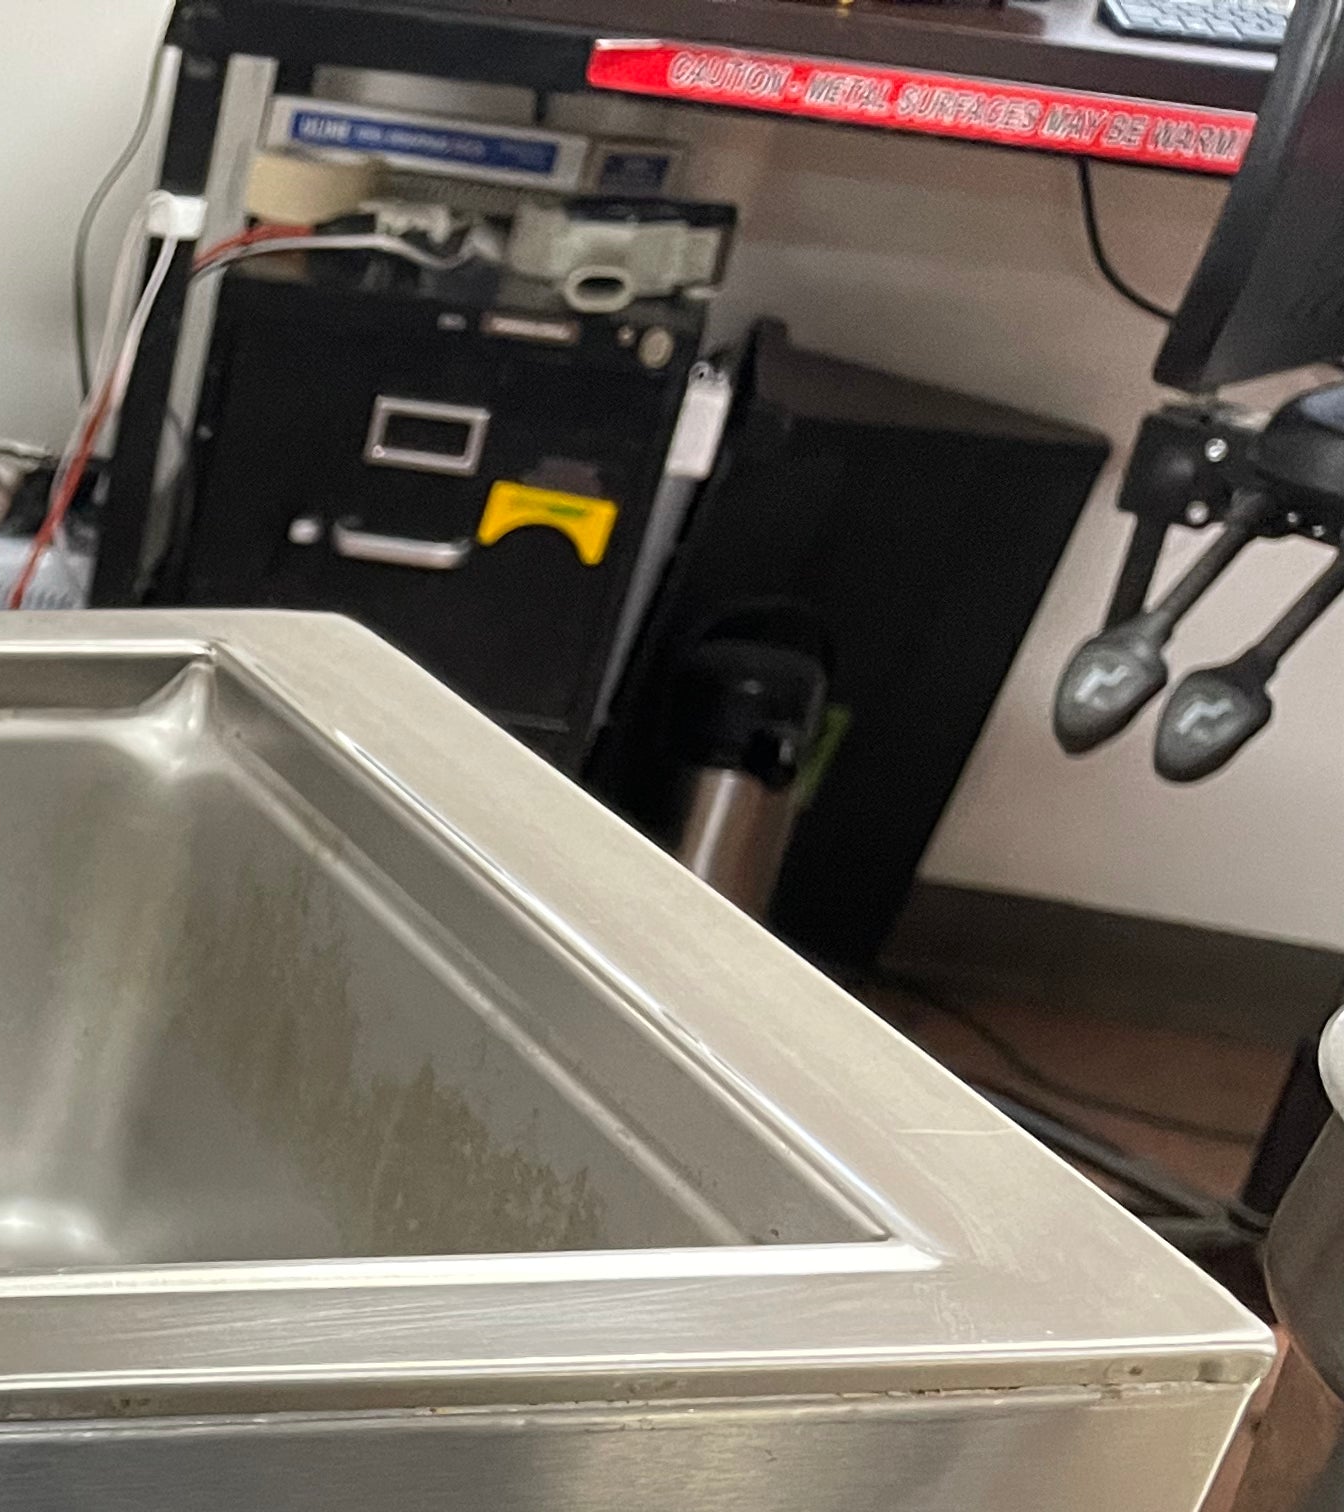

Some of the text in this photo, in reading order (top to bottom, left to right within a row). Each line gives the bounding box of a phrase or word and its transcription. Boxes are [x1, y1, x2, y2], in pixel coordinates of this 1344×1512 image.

[668, 51, 790, 100] CAUTION
[805, 70, 891, 113] METAL
[896, 83, 1041, 135] SURFACES
[1041, 102, 1108, 144] MAY
[1104, 112, 1147, 149] BE
